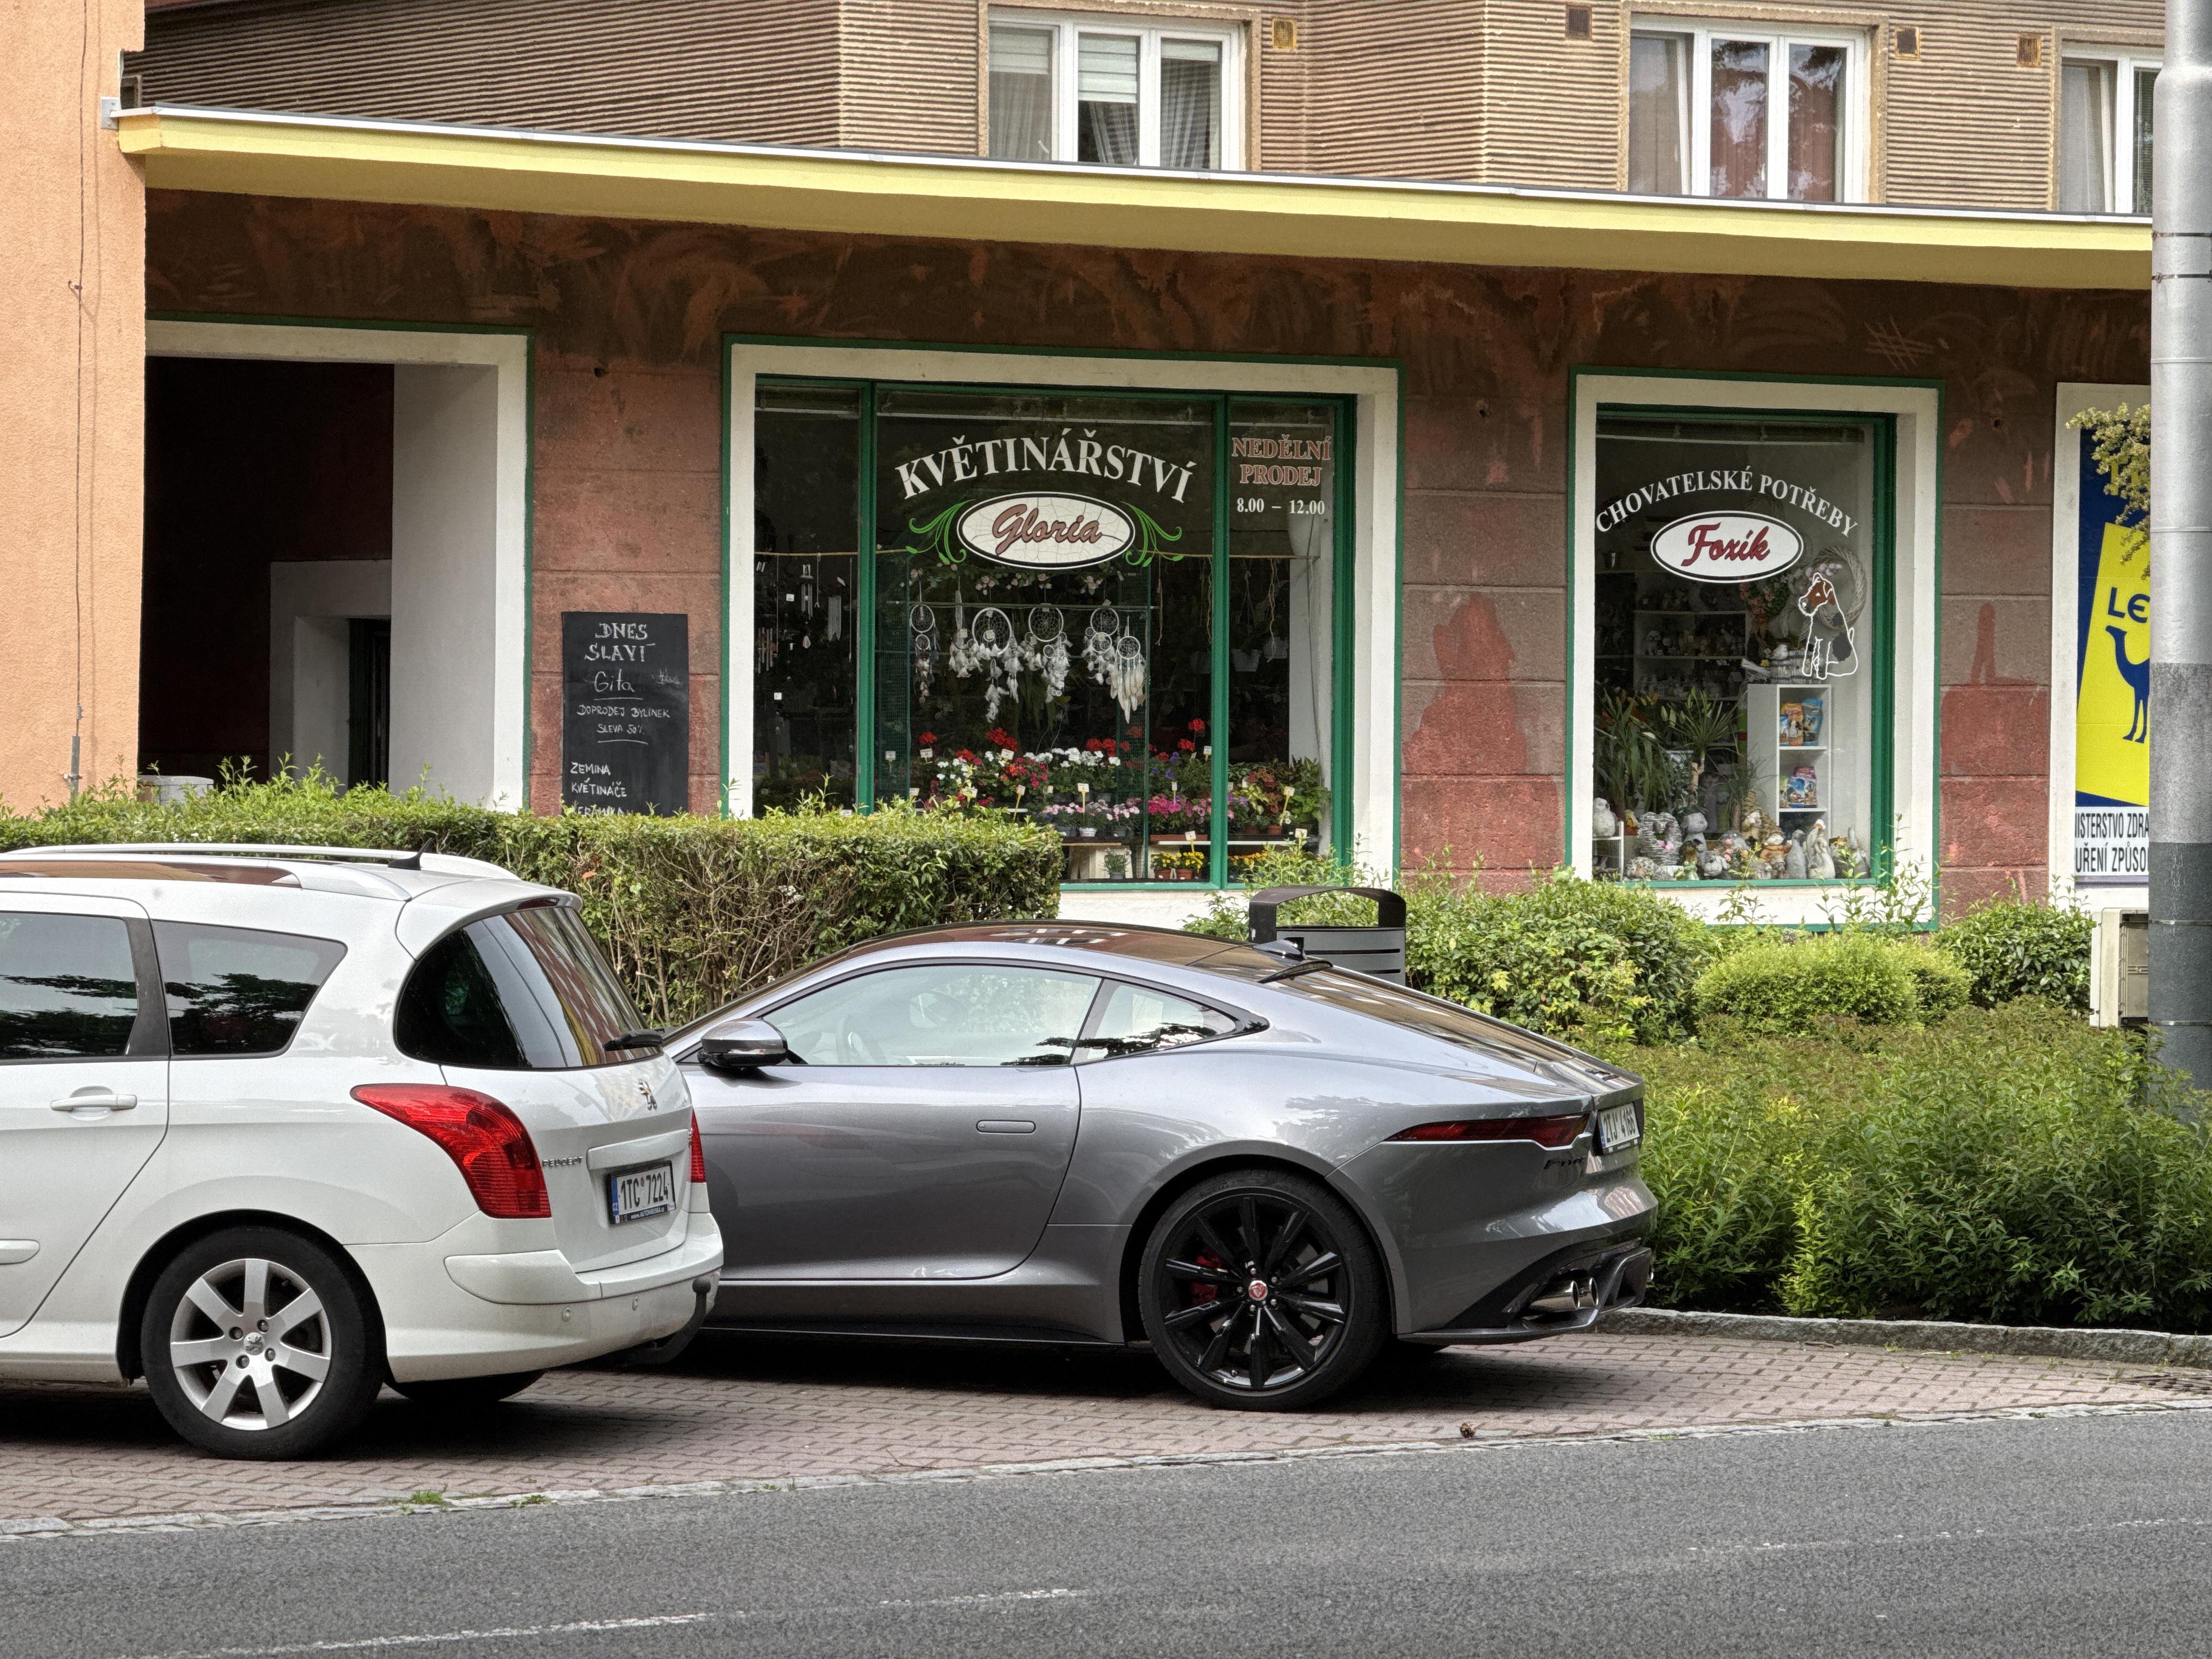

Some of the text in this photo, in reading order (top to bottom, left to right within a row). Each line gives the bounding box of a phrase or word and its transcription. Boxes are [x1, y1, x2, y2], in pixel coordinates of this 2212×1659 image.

[1232, 434, 1331, 460] NEDĚLNÍ
[895, 428, 1196, 502] KVĚTINÁŘSTVÍ
[1240, 465, 1322, 486] PRODEJ
[1237, 498, 1264, 513] 8.00
[1289, 499, 1325, 515] 12.00
[1596, 465, 1858, 538] CHOVATELSKÉ POTŘEBY
[992, 504, 1103, 555] Gloria
[1681, 522, 1770, 567] Foxík
[596, 623, 648, 640] DNES
[593, 668, 635, 693] Gita
[577, 704, 625, 716] DOPRODEJ
[597, 723, 623, 734] SLEVA
[570, 761, 611, 776] ZEMINA
[2112, 841, 2149, 873] ZPŮSO
[620, 1171, 669, 1210] 1TC 7224
